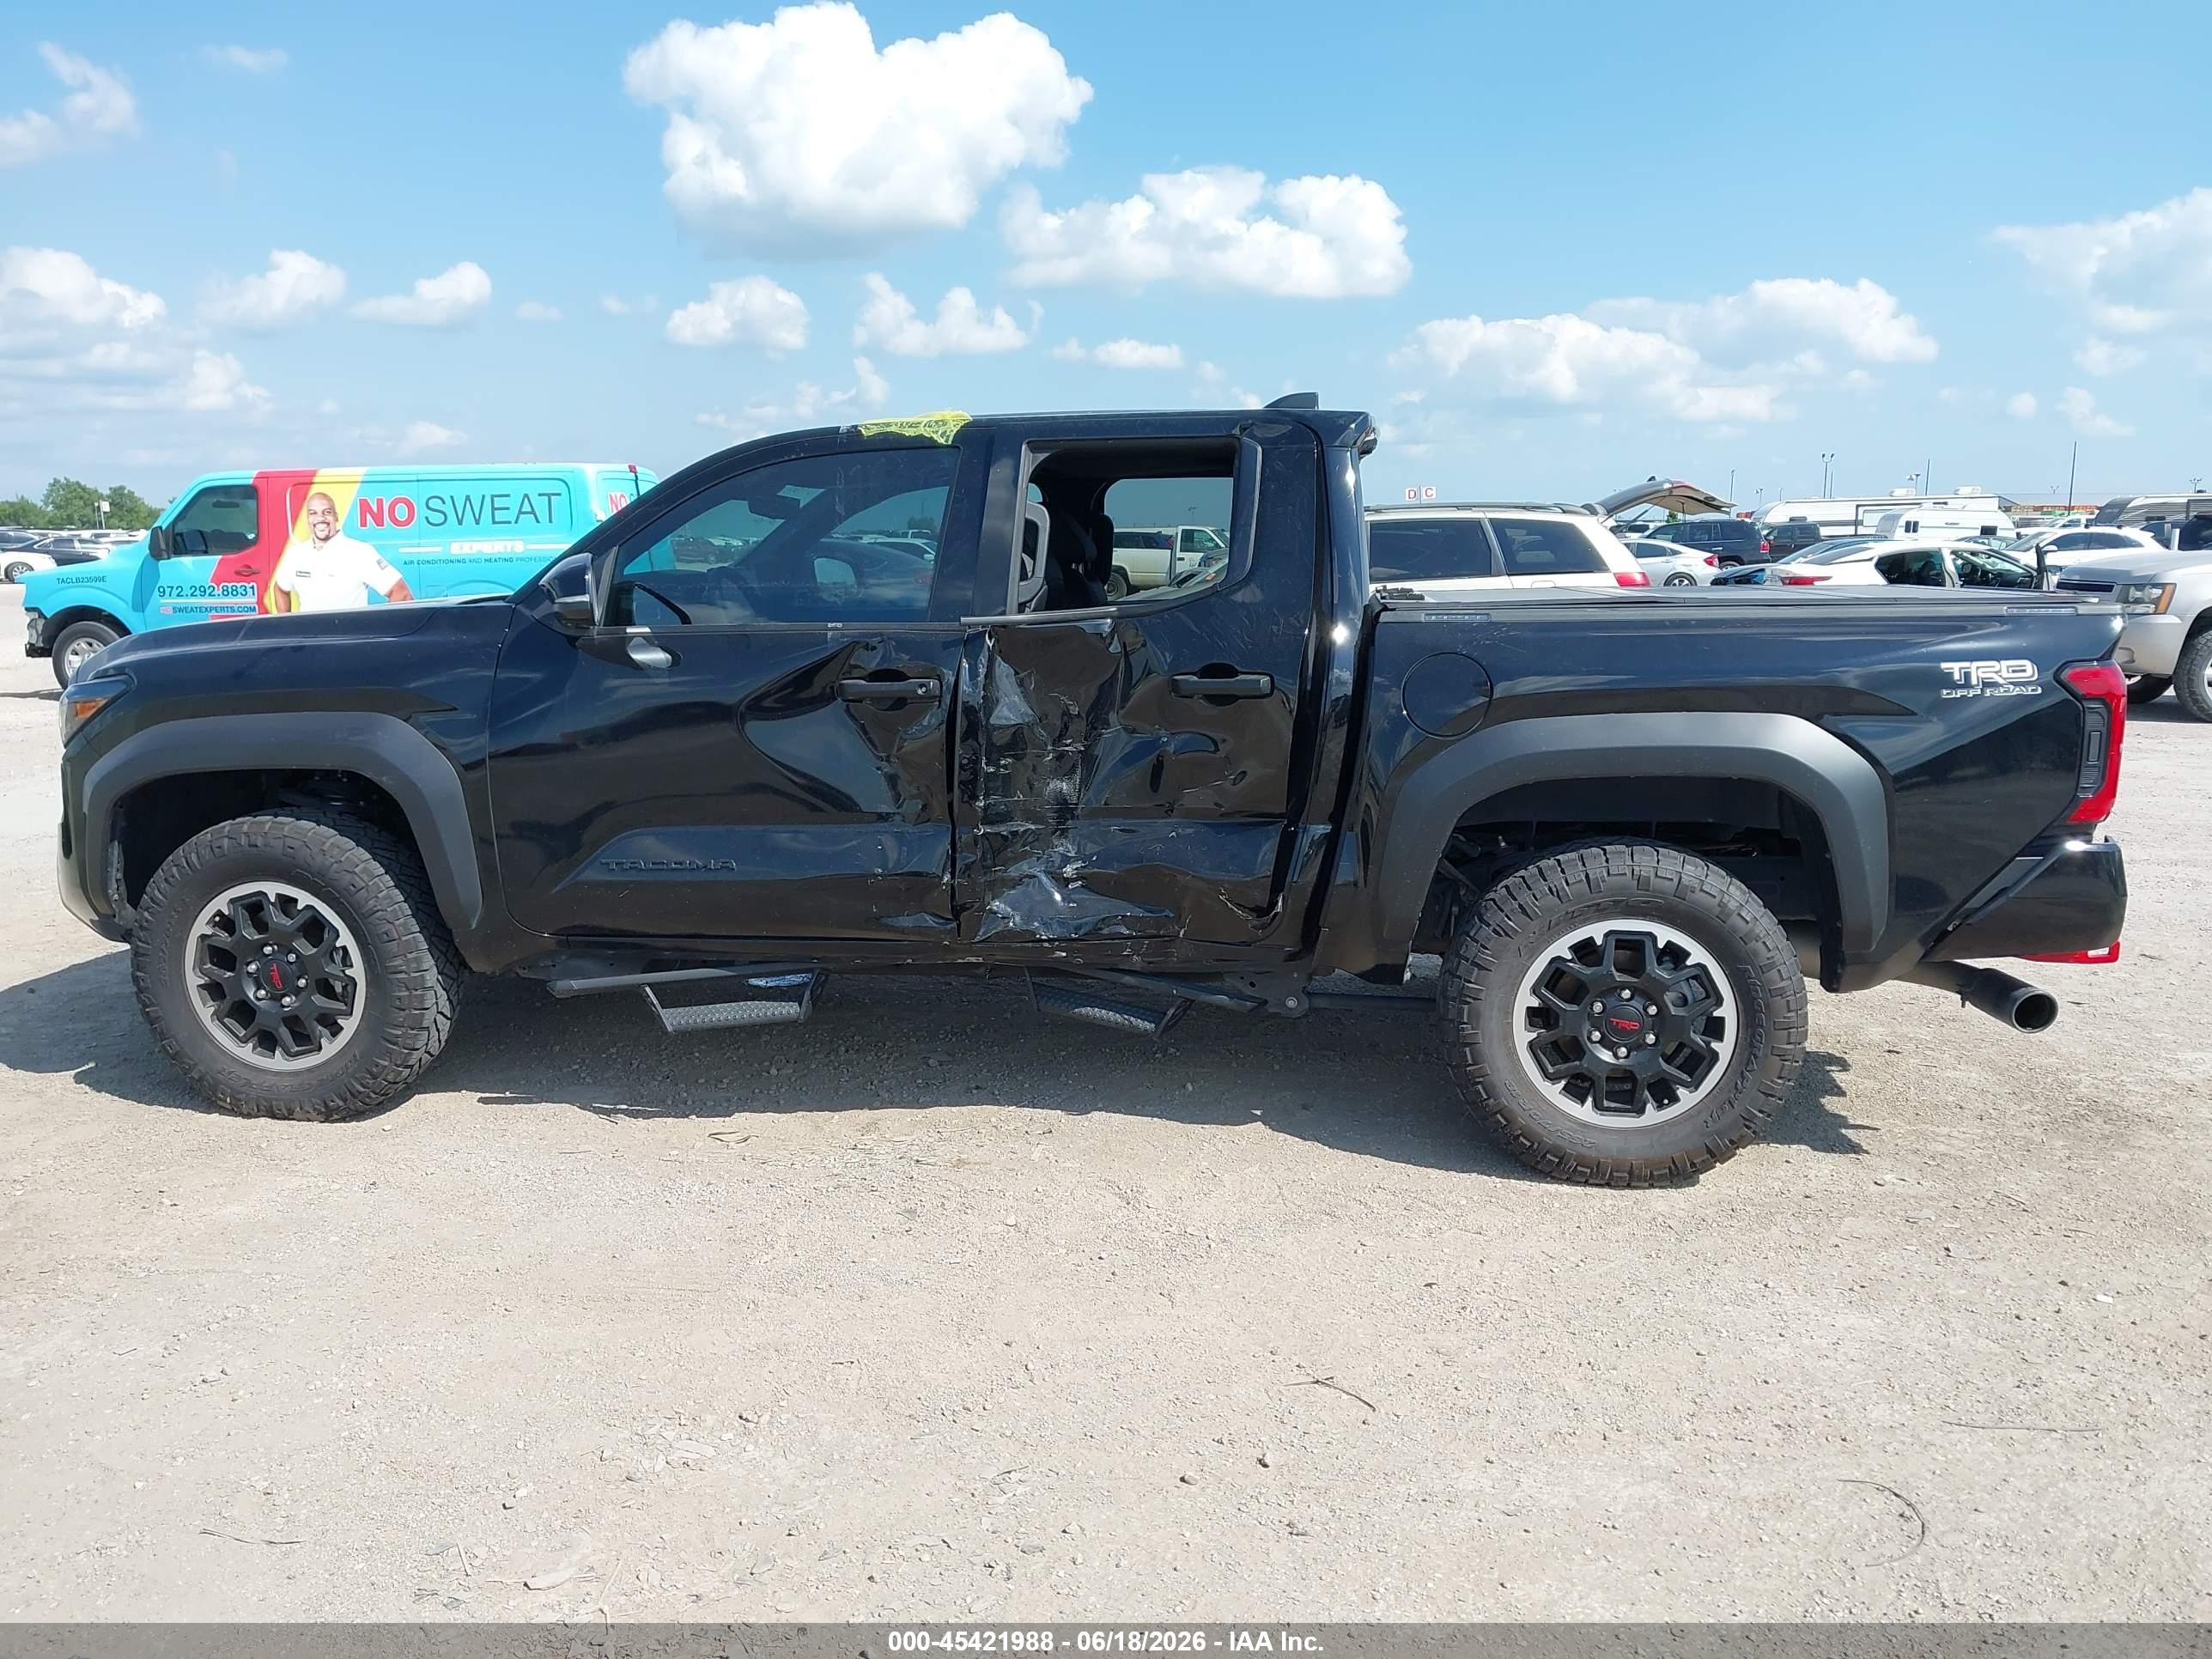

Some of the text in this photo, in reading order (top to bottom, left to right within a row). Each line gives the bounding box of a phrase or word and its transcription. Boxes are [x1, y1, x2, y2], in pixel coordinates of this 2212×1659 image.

[1407, 489, 1417, 500] D
[1425, 487, 1434, 498] C
[357, 492, 562, 528] NO SWEAT
[416, 556, 467, 566] CONDITIONING
[468, 556, 483, 565] AND
[483, 556, 514, 565] HEATING
[157, 584, 257, 599] 972.292.8831
[1940, 659, 2039, 690] TRD
[1940, 685, 2042, 699] OFF ROAD
[601, 858, 738, 872] TACOMA
[270, 962, 283, 990] TRD
[1609, 1017, 1642, 1031] TRD
